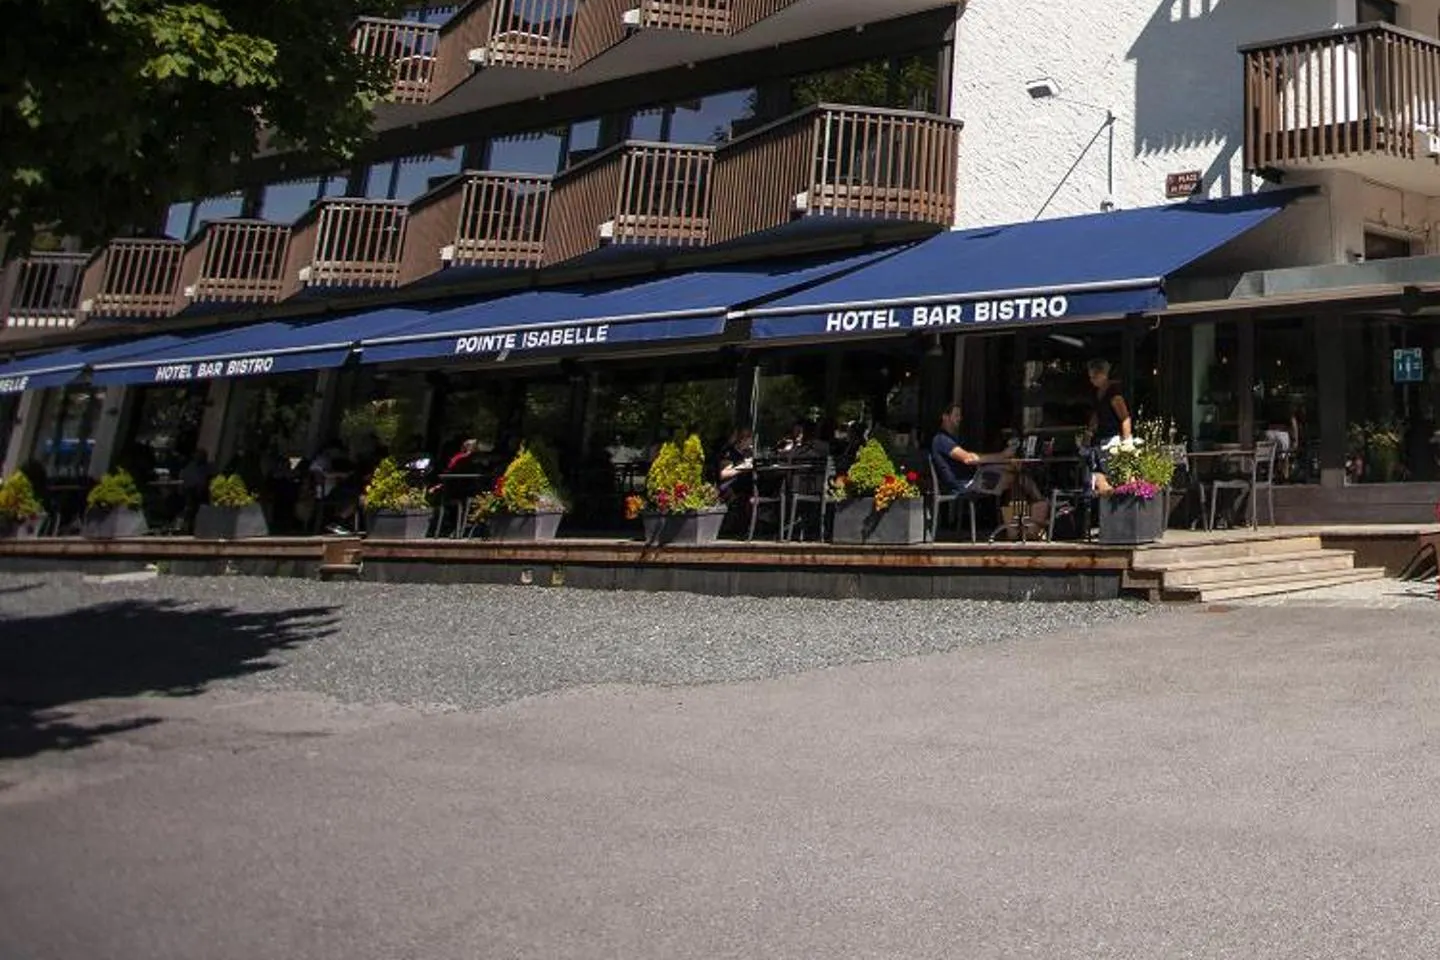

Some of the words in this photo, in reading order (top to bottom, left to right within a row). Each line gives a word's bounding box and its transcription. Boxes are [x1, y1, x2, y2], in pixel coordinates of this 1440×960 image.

[826, 309, 900, 332] HOTEL
[912, 304, 962, 326] BAR
[974, 295, 1068, 321] BISTRO
[455, 333, 516, 354] POINTE
[521, 324, 609, 348] ISABELLE
[155, 366, 192, 382] HOTEL
[196, 361, 221, 378] BAR
[226, 356, 274, 377] BISTRO
